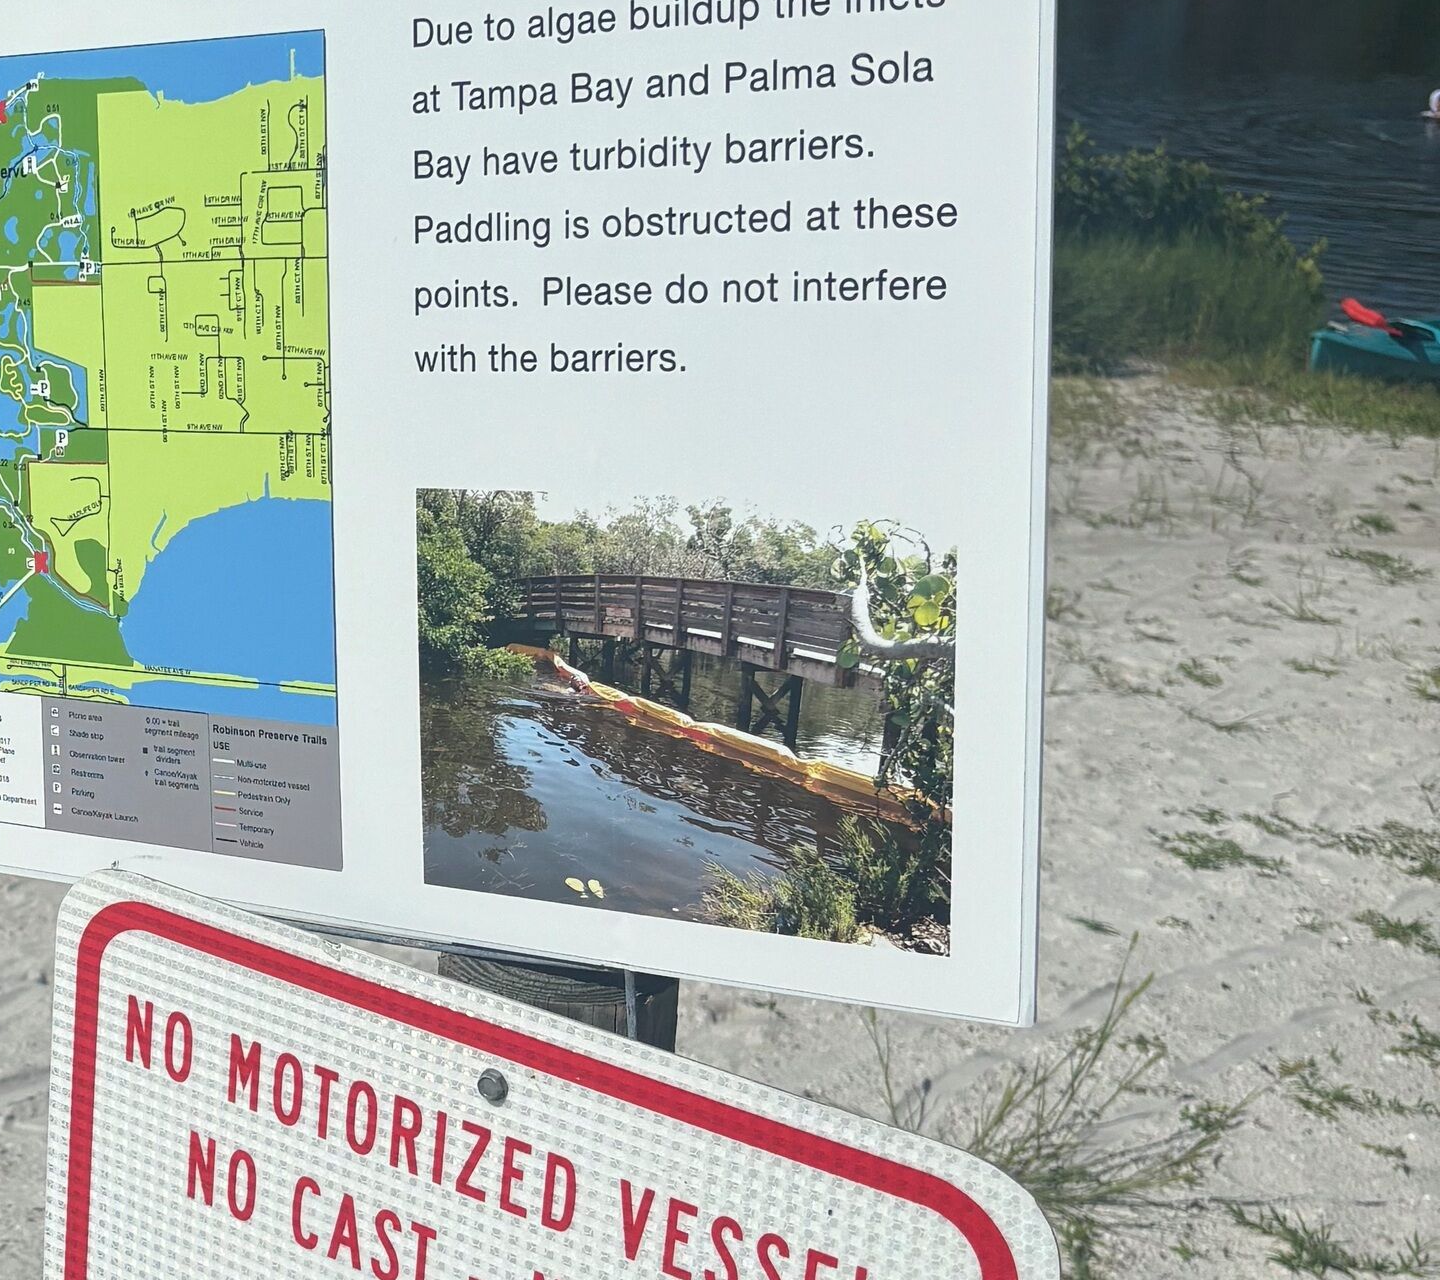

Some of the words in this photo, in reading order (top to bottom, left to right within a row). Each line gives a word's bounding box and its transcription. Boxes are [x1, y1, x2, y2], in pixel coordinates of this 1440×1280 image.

[414, 18, 472, 47] Due
[484, 14, 514, 41] to
[528, 7, 615, 43] algae
[413, 85, 440, 113] at
[451, 81, 557, 114] Tampa
[572, 73, 633, 108] Bay
[647, 64, 708, 98] and
[726, 59, 836, 93] Palma
[851, 51, 933, 86] Sola
[415, 150, 470, 185] Bay
[484, 147, 557, 175] have
[570, 136, 711, 173] turbidity
[726, 129, 873, 163] barriers.
[415, 212, 550, 247] Paddling
[566, 210, 589, 239] is
[603, 201, 790, 237] obstructed
[807, 201, 839, 231] at
[854, 198, 957, 229] these
[415, 280, 517, 316] points.
[544, 277, 651, 306] Please
[666, 274, 708, 304] do
[724, 273, 778, 302] not
[794, 269, 946, 301] interfere
[415, 344, 475, 372] with
[488, 344, 537, 372] the
[551, 343, 685, 372] barriers.
[69, 729, 89, 739] Shade
[212, 724, 255, 738] Robinson
[258, 729, 299, 742] Preserve
[302, 734, 327, 745] Trails
[167, 747, 196, 757] segment
[213, 741, 230, 751] USE
[69, 751, 106, 762] Observation
[155, 755, 181, 765] dividers
[275, 795, 291, 806] Only
[114, 813, 138, 823] Launch
[239, 807, 264, 818] Service
[240, 823, 274, 836] Temporary
[240, 839, 264, 849] Vehicle
[126, 997, 191, 1081] NO
[228, 1036, 575, 1232] MOTORIZED
[188, 1132, 255, 1220] NO
